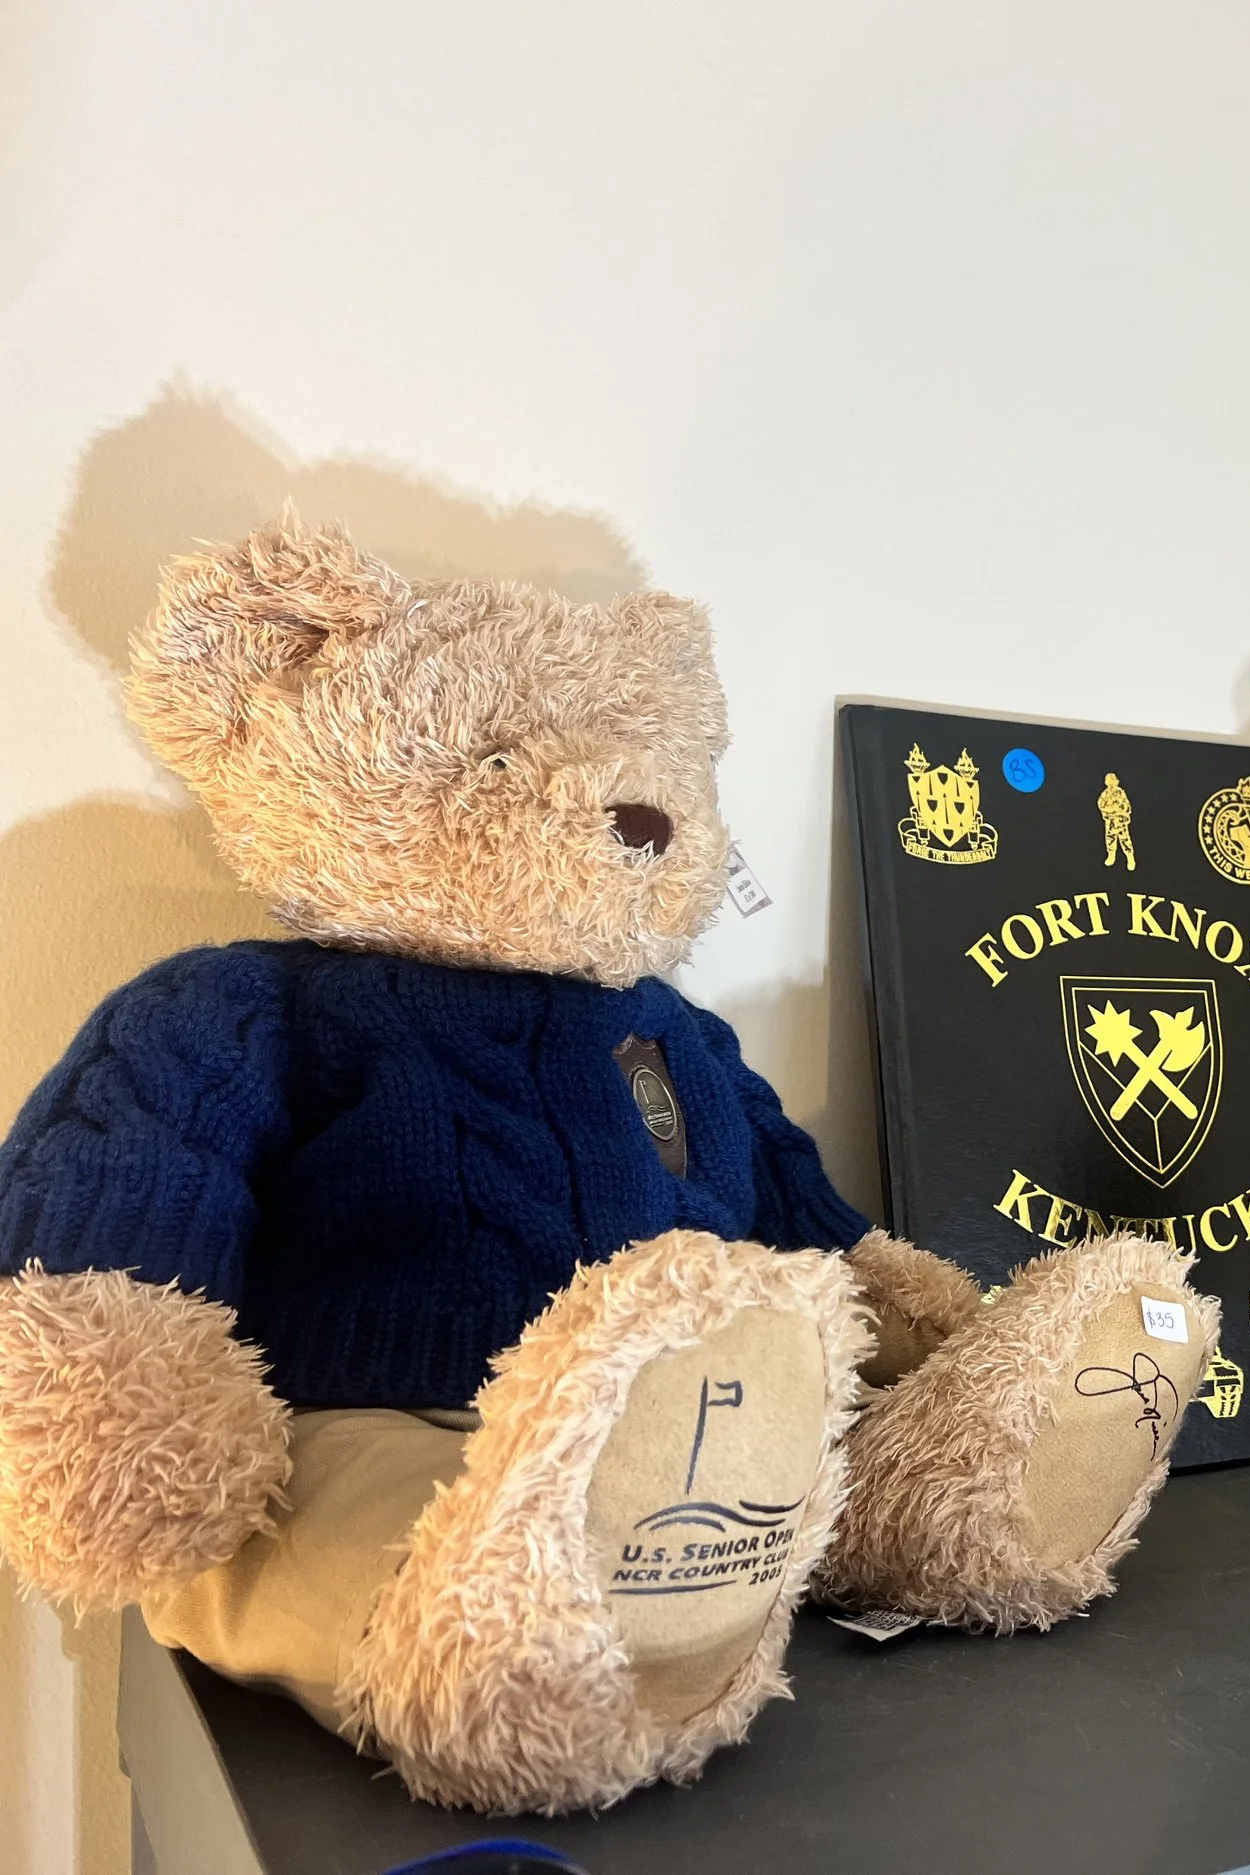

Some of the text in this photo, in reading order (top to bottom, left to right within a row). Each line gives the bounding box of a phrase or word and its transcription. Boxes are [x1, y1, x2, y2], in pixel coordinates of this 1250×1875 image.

[1209, 845, 1233, 873] THIS
[964, 891, 1110, 988] FORT
[1146, 1305, 1175, 1329] $35
[621, 1544, 673, 1564] U.S.
[680, 1536, 760, 1562] SENIOR
[613, 1568, 663, 1582] NCR
[668, 1555, 762, 1580] COUNTRY
